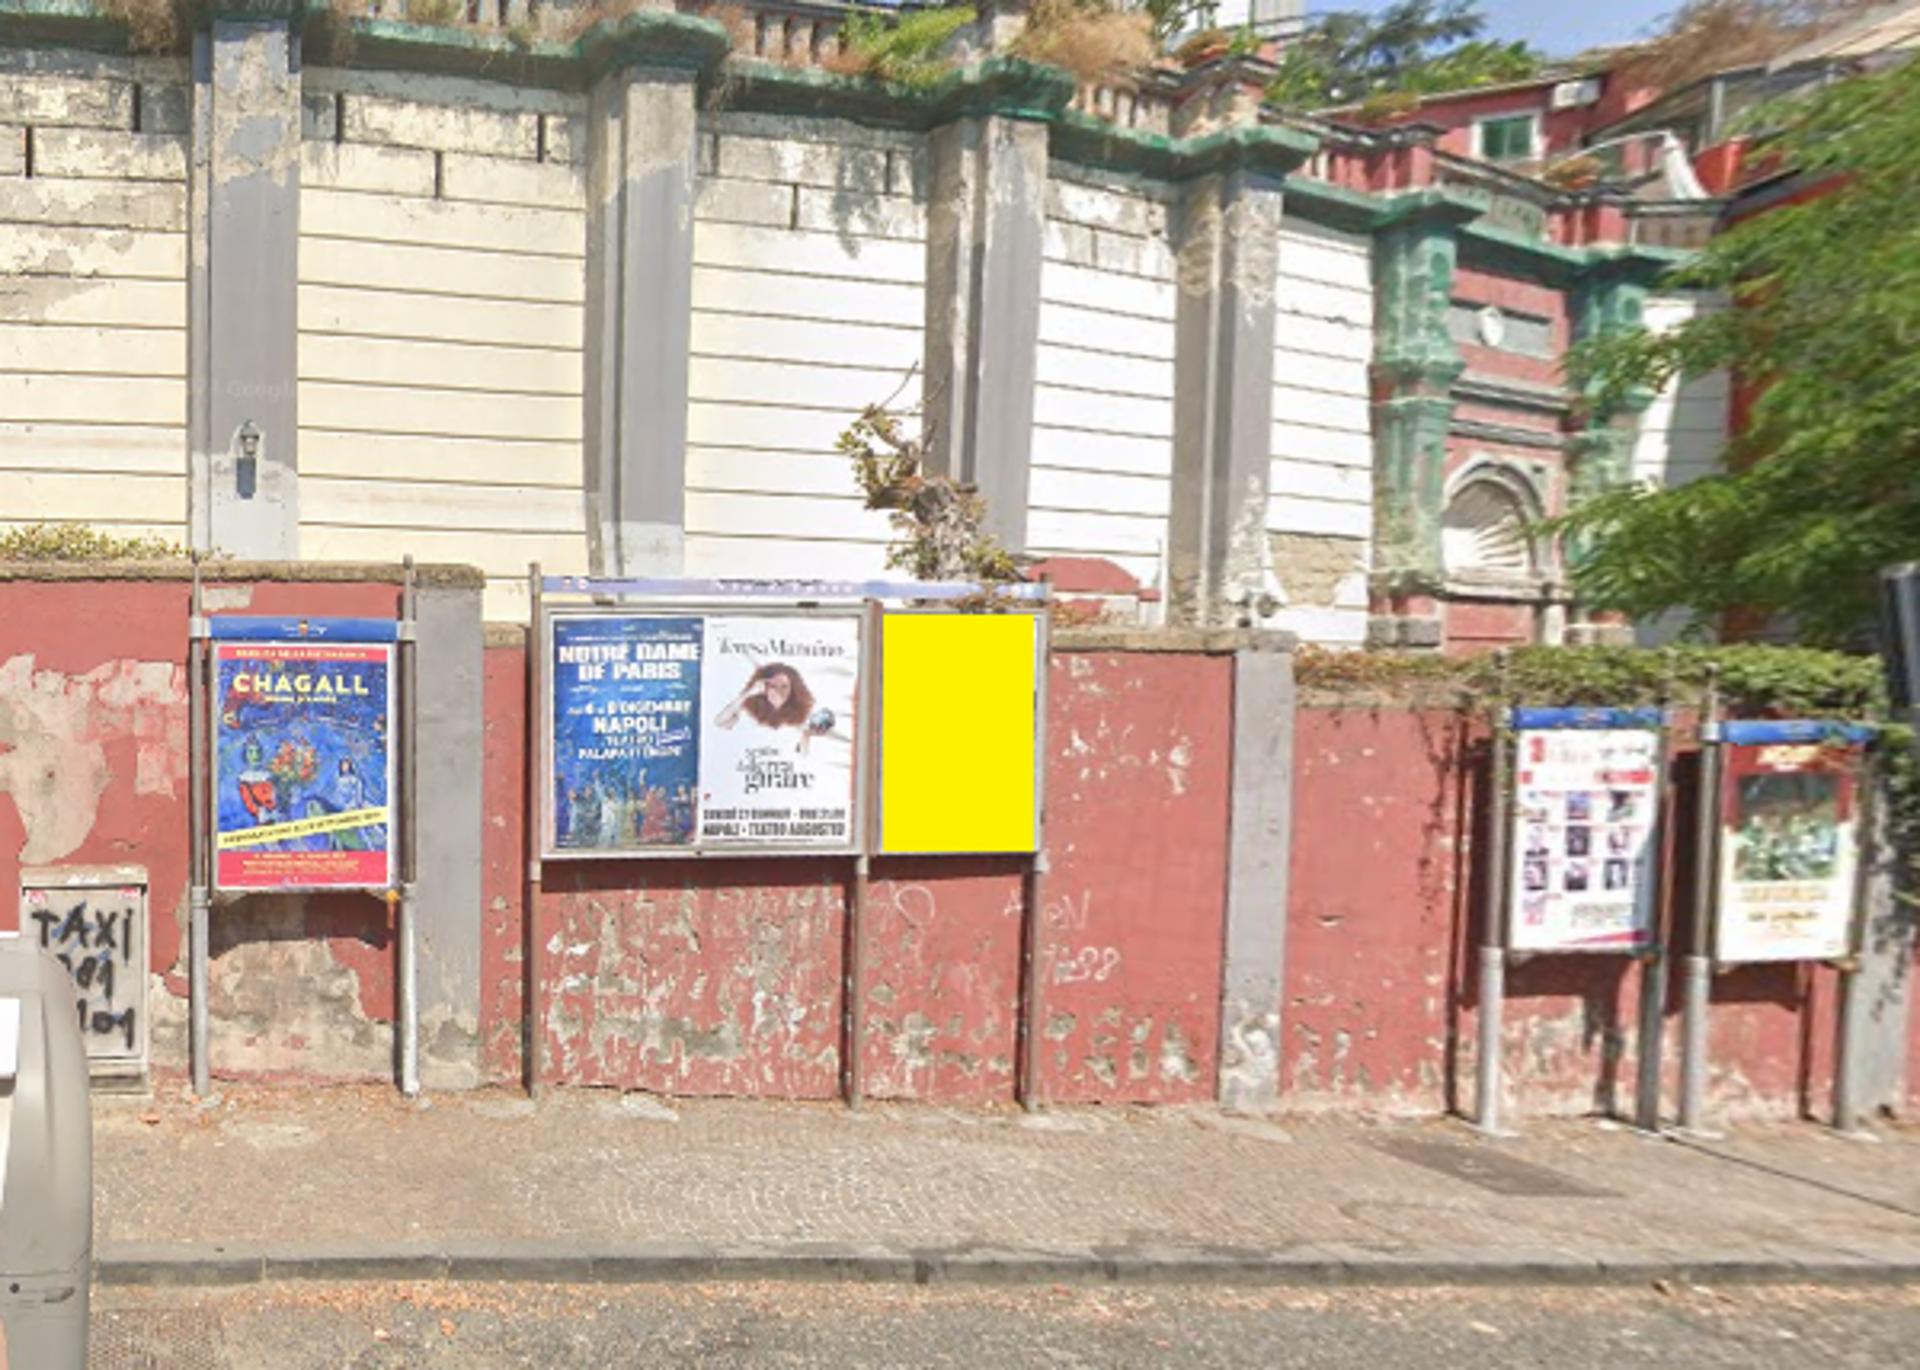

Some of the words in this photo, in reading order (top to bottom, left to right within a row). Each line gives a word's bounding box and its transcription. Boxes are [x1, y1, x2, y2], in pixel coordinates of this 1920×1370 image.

[559, 642, 628, 663] NOTRE
[636, 642, 700, 661] DAME
[579, 662, 607, 681] DE
[613, 661, 682, 680] PARIS
[233, 672, 369, 695] CHAGALL
[594, 715, 667, 734] NAPOLI
[31, 901, 132, 966] TAXI
